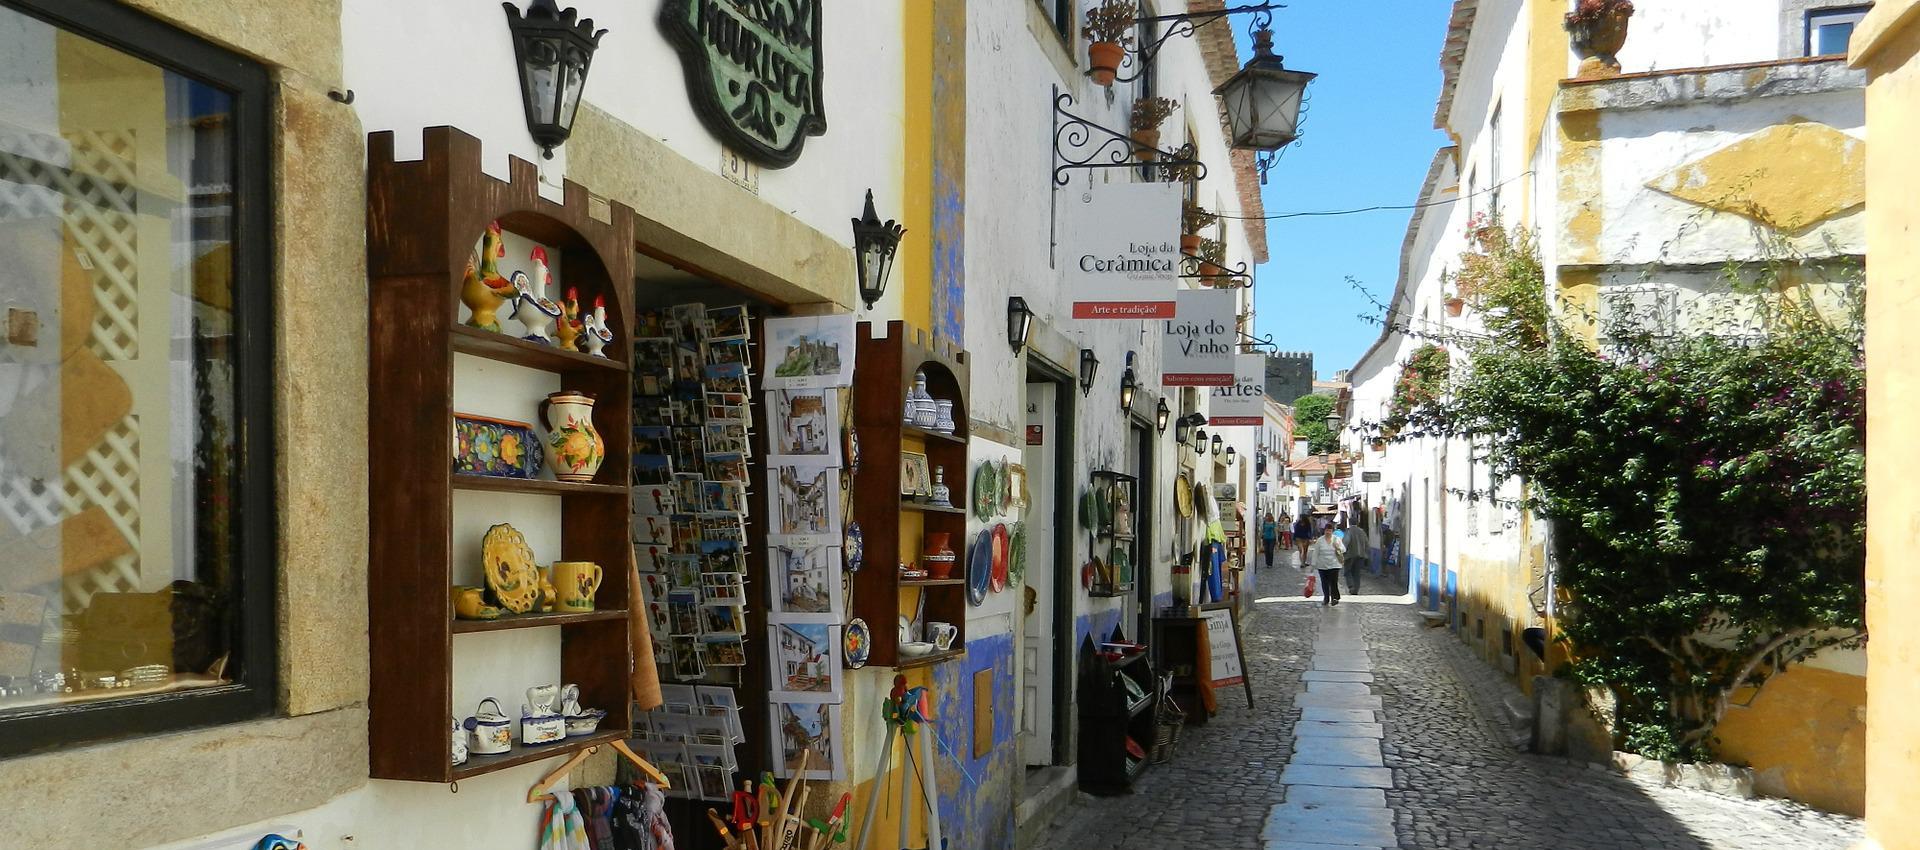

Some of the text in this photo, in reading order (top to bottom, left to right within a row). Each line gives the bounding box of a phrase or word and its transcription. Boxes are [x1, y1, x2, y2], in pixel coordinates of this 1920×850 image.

[1129, 242, 1173, 255] Loja da
[1080, 253, 1172, 273] Cerâmica
[1091, 305, 1111, 314] Arte
[1120, 305, 1157, 316] tradição!
[1166, 319, 1225, 339] Loja do
[1212, 382, 1264, 397] Artes
